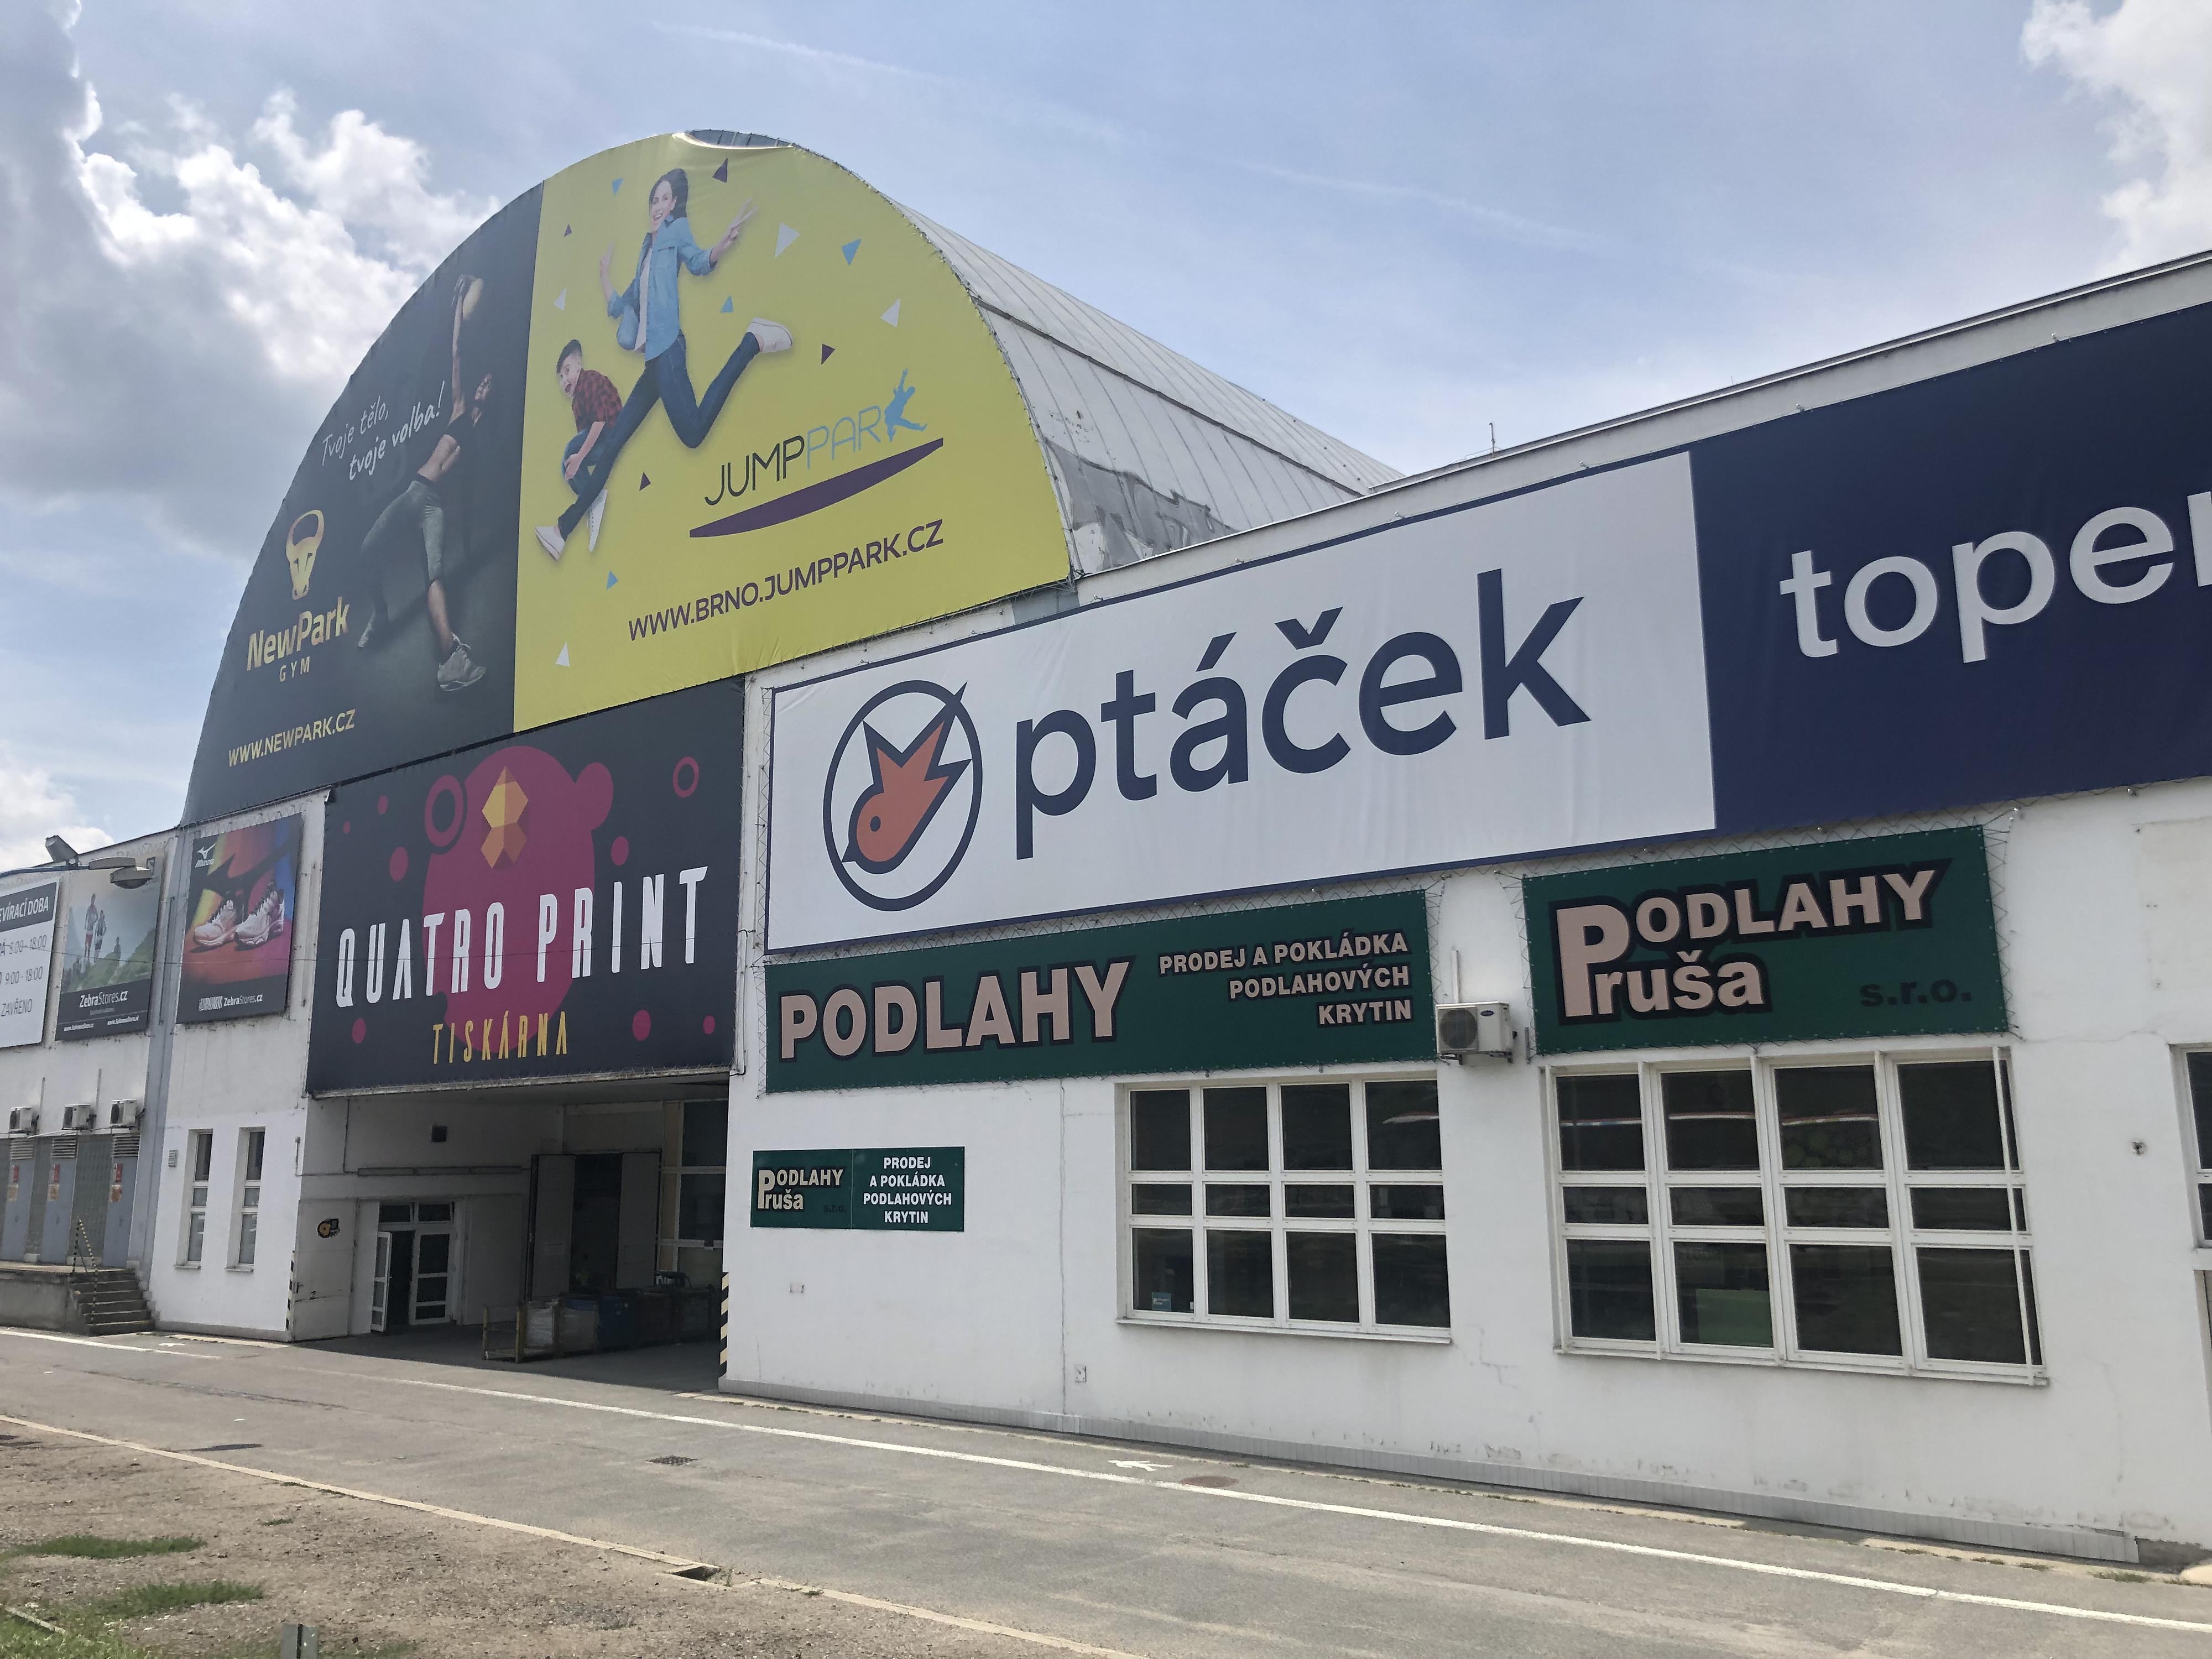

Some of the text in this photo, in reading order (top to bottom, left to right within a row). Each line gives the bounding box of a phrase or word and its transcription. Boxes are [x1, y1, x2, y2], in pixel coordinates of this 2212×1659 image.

[322, 395, 388, 466] Tvoje tělo,
[349, 380, 445, 481] tvoje volba!
[628, 519, 943, 641] WWW.BRNO.JUMPPARK.CZ
[247, 597, 349, 671] NewPark
[279, 658, 311, 682] GYM
[1015, 568, 1592, 859] ptáček
[228, 708, 356, 767] WWW.NEWPARK.CZ
[27, 896, 49, 916] DOBA
[336, 866, 708, 1008] QUATRO PRINT
[1159, 931, 1409, 975] PRODEJ A POKLÁDKA
[1229, 964, 1410, 1000] PODLAHOVÝCH
[1860, 977, 1972, 1007] s.r.o.
[780, 961, 1130, 1060] PODLAHY
[1318, 999, 1412, 1026] KRYTIN
[433, 1010, 567, 1065] TISKÁRNA
[869, 1171, 945, 1188] A POKLÁDKA
[883, 1156, 932, 1169] PRODEJ
[863, 1190, 952, 1206] PODLAHOVÝCH
[884, 1211, 928, 1223] KRYTIN
